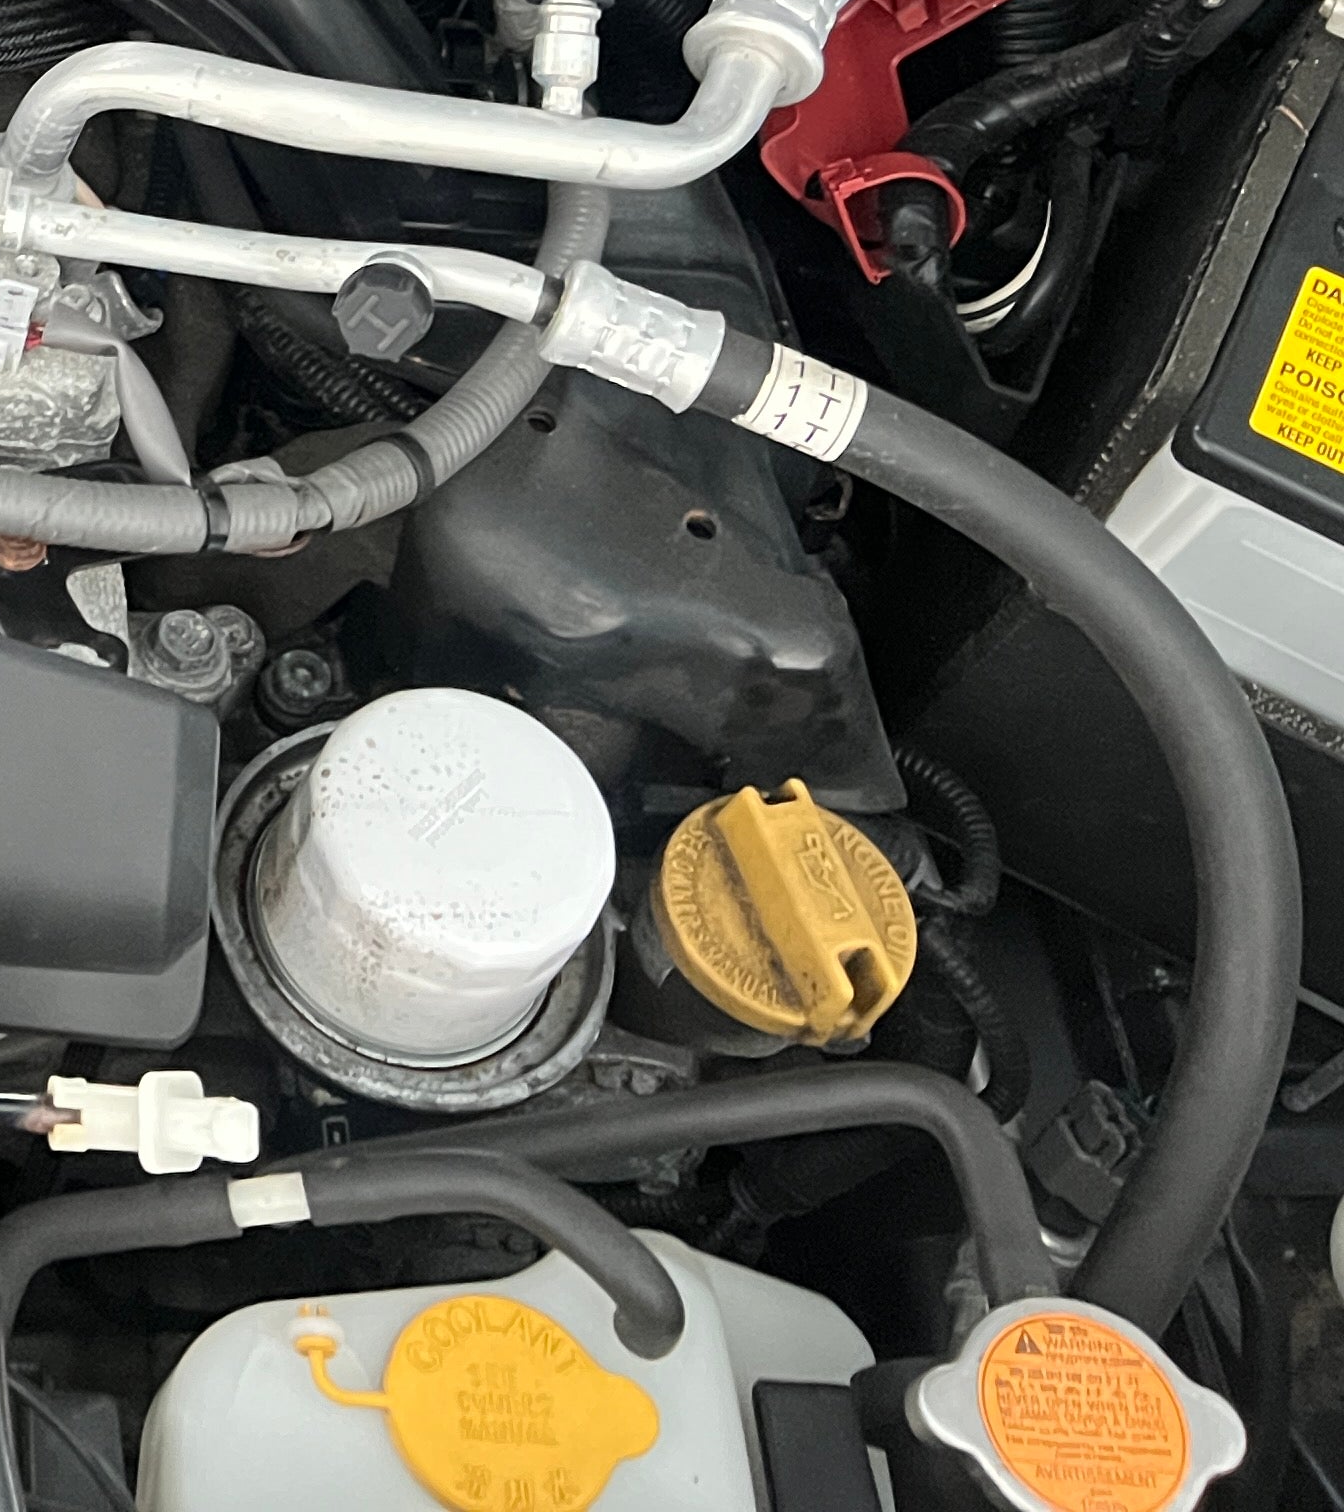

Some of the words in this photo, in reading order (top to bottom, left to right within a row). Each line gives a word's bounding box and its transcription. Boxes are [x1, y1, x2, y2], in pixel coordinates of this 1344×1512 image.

[1312, 279, 1344, 306] DA
[1298, 317, 1313, 331] Do
[1314, 326, 1333, 341] not
[1305, 347, 1343, 372] KEEP
[1270, 393, 1295, 410] eyes
[1274, 380, 1320, 409] Contains
[1267, 404, 1298, 424] water
[1301, 420, 1321, 435] and
[1276, 422, 1315, 448] KEEP
[407, 1301, 578, 1374] COOLANT
